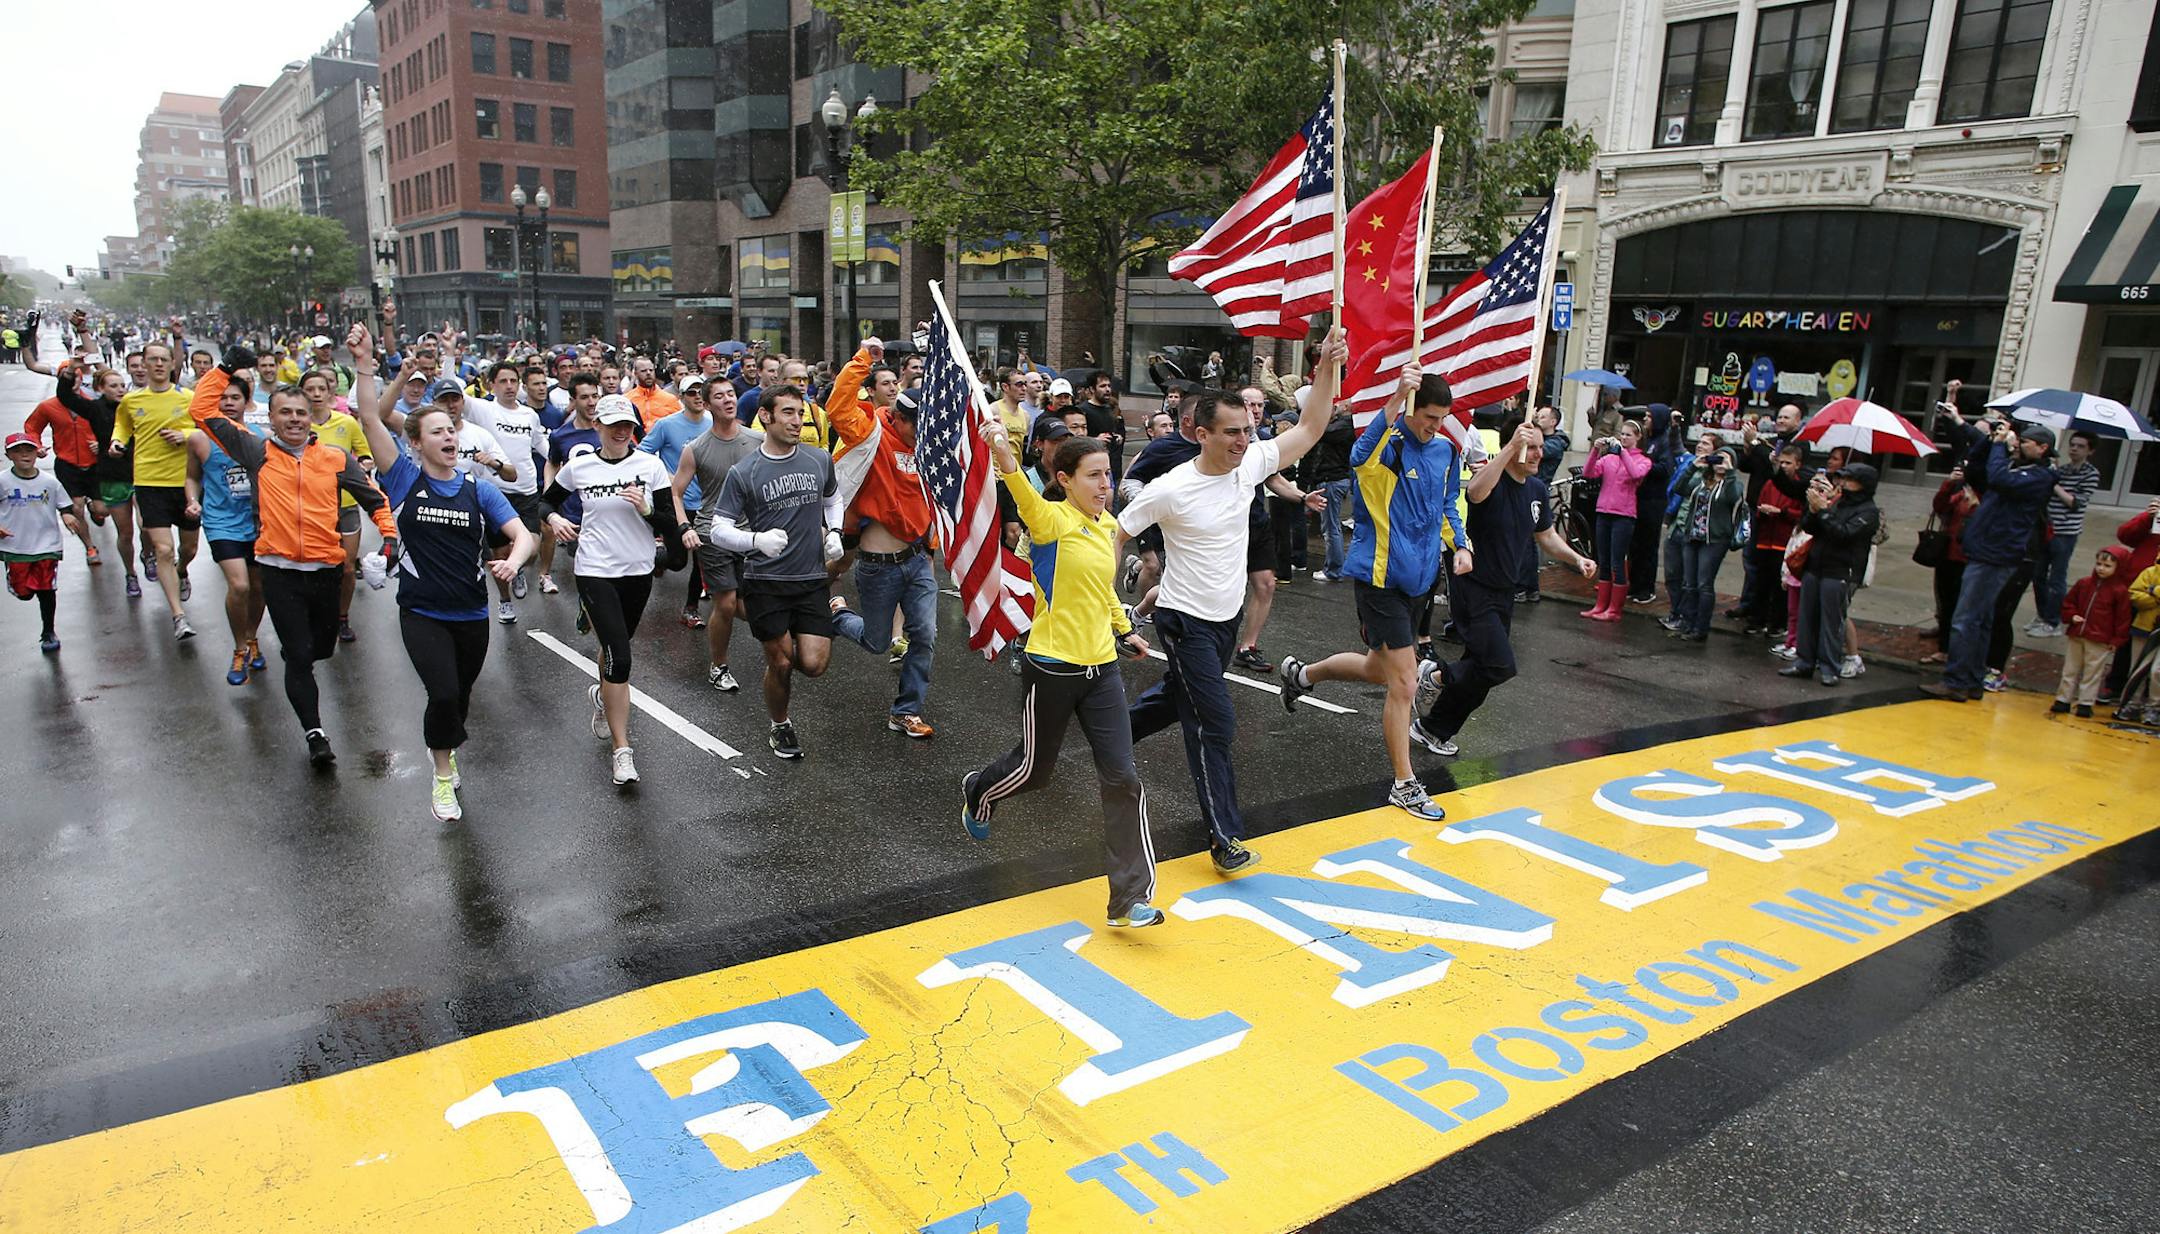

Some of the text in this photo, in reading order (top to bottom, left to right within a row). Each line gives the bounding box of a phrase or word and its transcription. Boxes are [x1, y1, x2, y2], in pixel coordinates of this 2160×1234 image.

[1738, 166, 1871, 196] GOODYEAR
[2121, 286, 2149, 299] 665
[1702, 311, 1872, 331] SUGARY HEAVEN
[1704, 395, 1740, 411] OPEN
[762, 473, 818, 502] CAMBRIDGE
[767, 493, 818, 511] RUNNING CLUB
[416, 515, 470, 527] RUNNING CLUB
[417, 506, 470, 520] CAMBRIDGE
[1333, 819, 2103, 1134] Boston Marathon
[444, 739, 1996, 1234] FINISH
